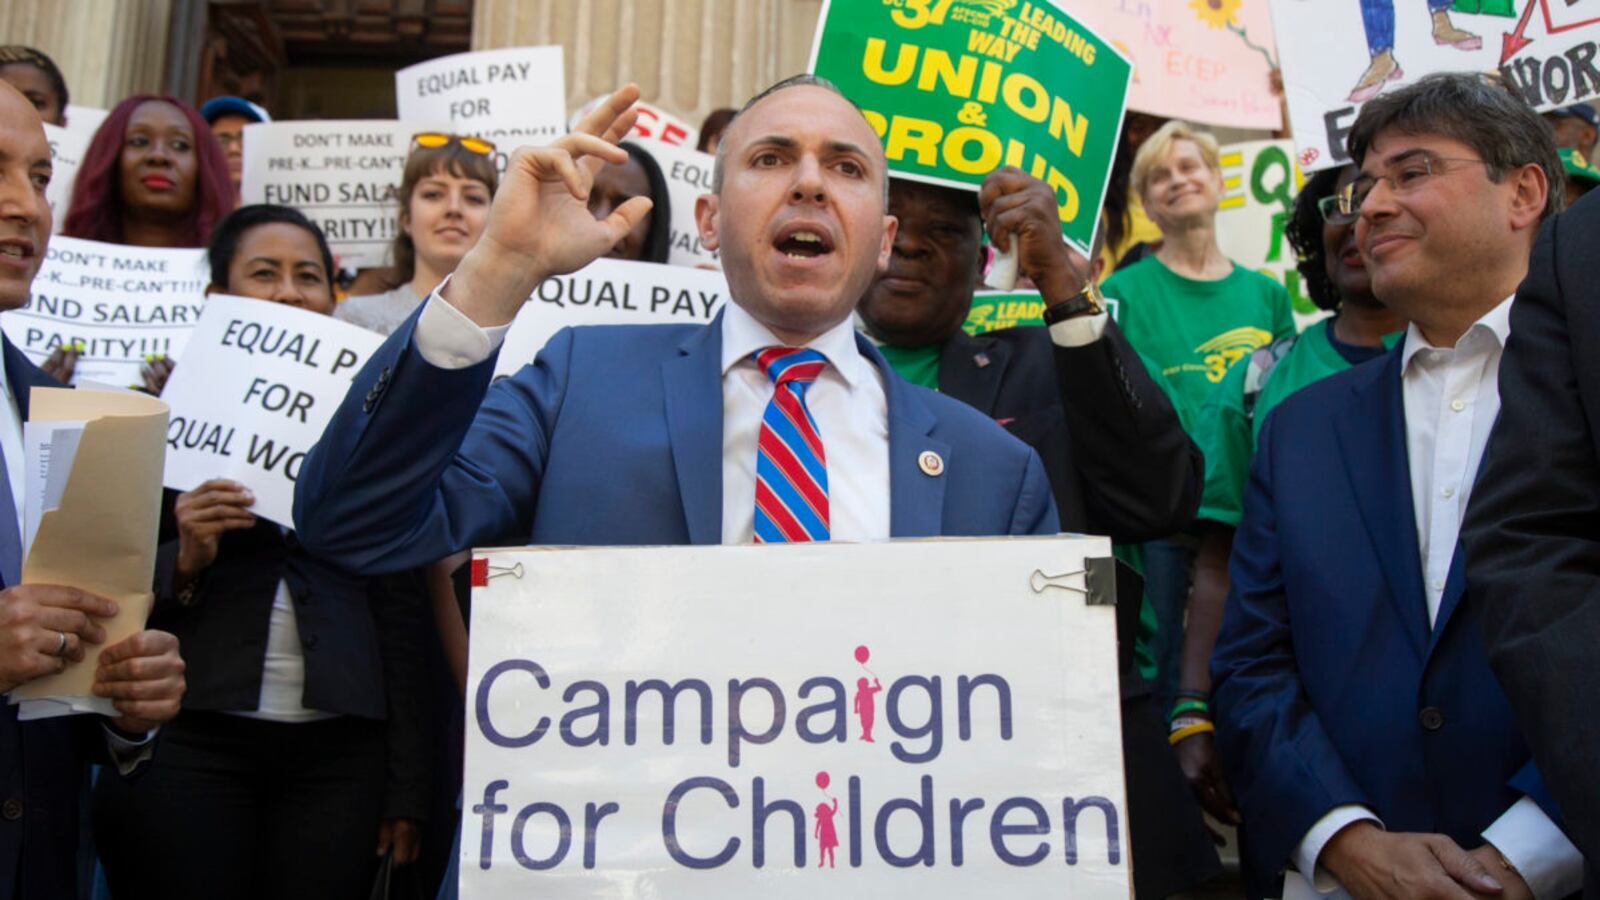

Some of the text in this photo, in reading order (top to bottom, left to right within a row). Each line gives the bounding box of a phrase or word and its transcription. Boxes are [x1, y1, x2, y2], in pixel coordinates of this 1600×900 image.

[967, 28, 1023, 63] WAY
[1000, 16, 1042, 51] THE
[1018, 1, 1097, 66] LEADING
[417, 62, 531, 97] EQUAL PAY
[862, 36, 1090, 158] UNION
[450, 99, 490, 120] FOR
[956, 101, 988, 127] &
[293, 133, 394, 148] DON'T MAKE
[264, 182, 330, 204] FUND
[112, 256, 169, 273] MAKE
[524, 276, 719, 319] QUAL PAY
[221, 319, 321, 368] EQUAL
[242, 377, 315, 424] FOR
[472, 779, 620, 871] for
